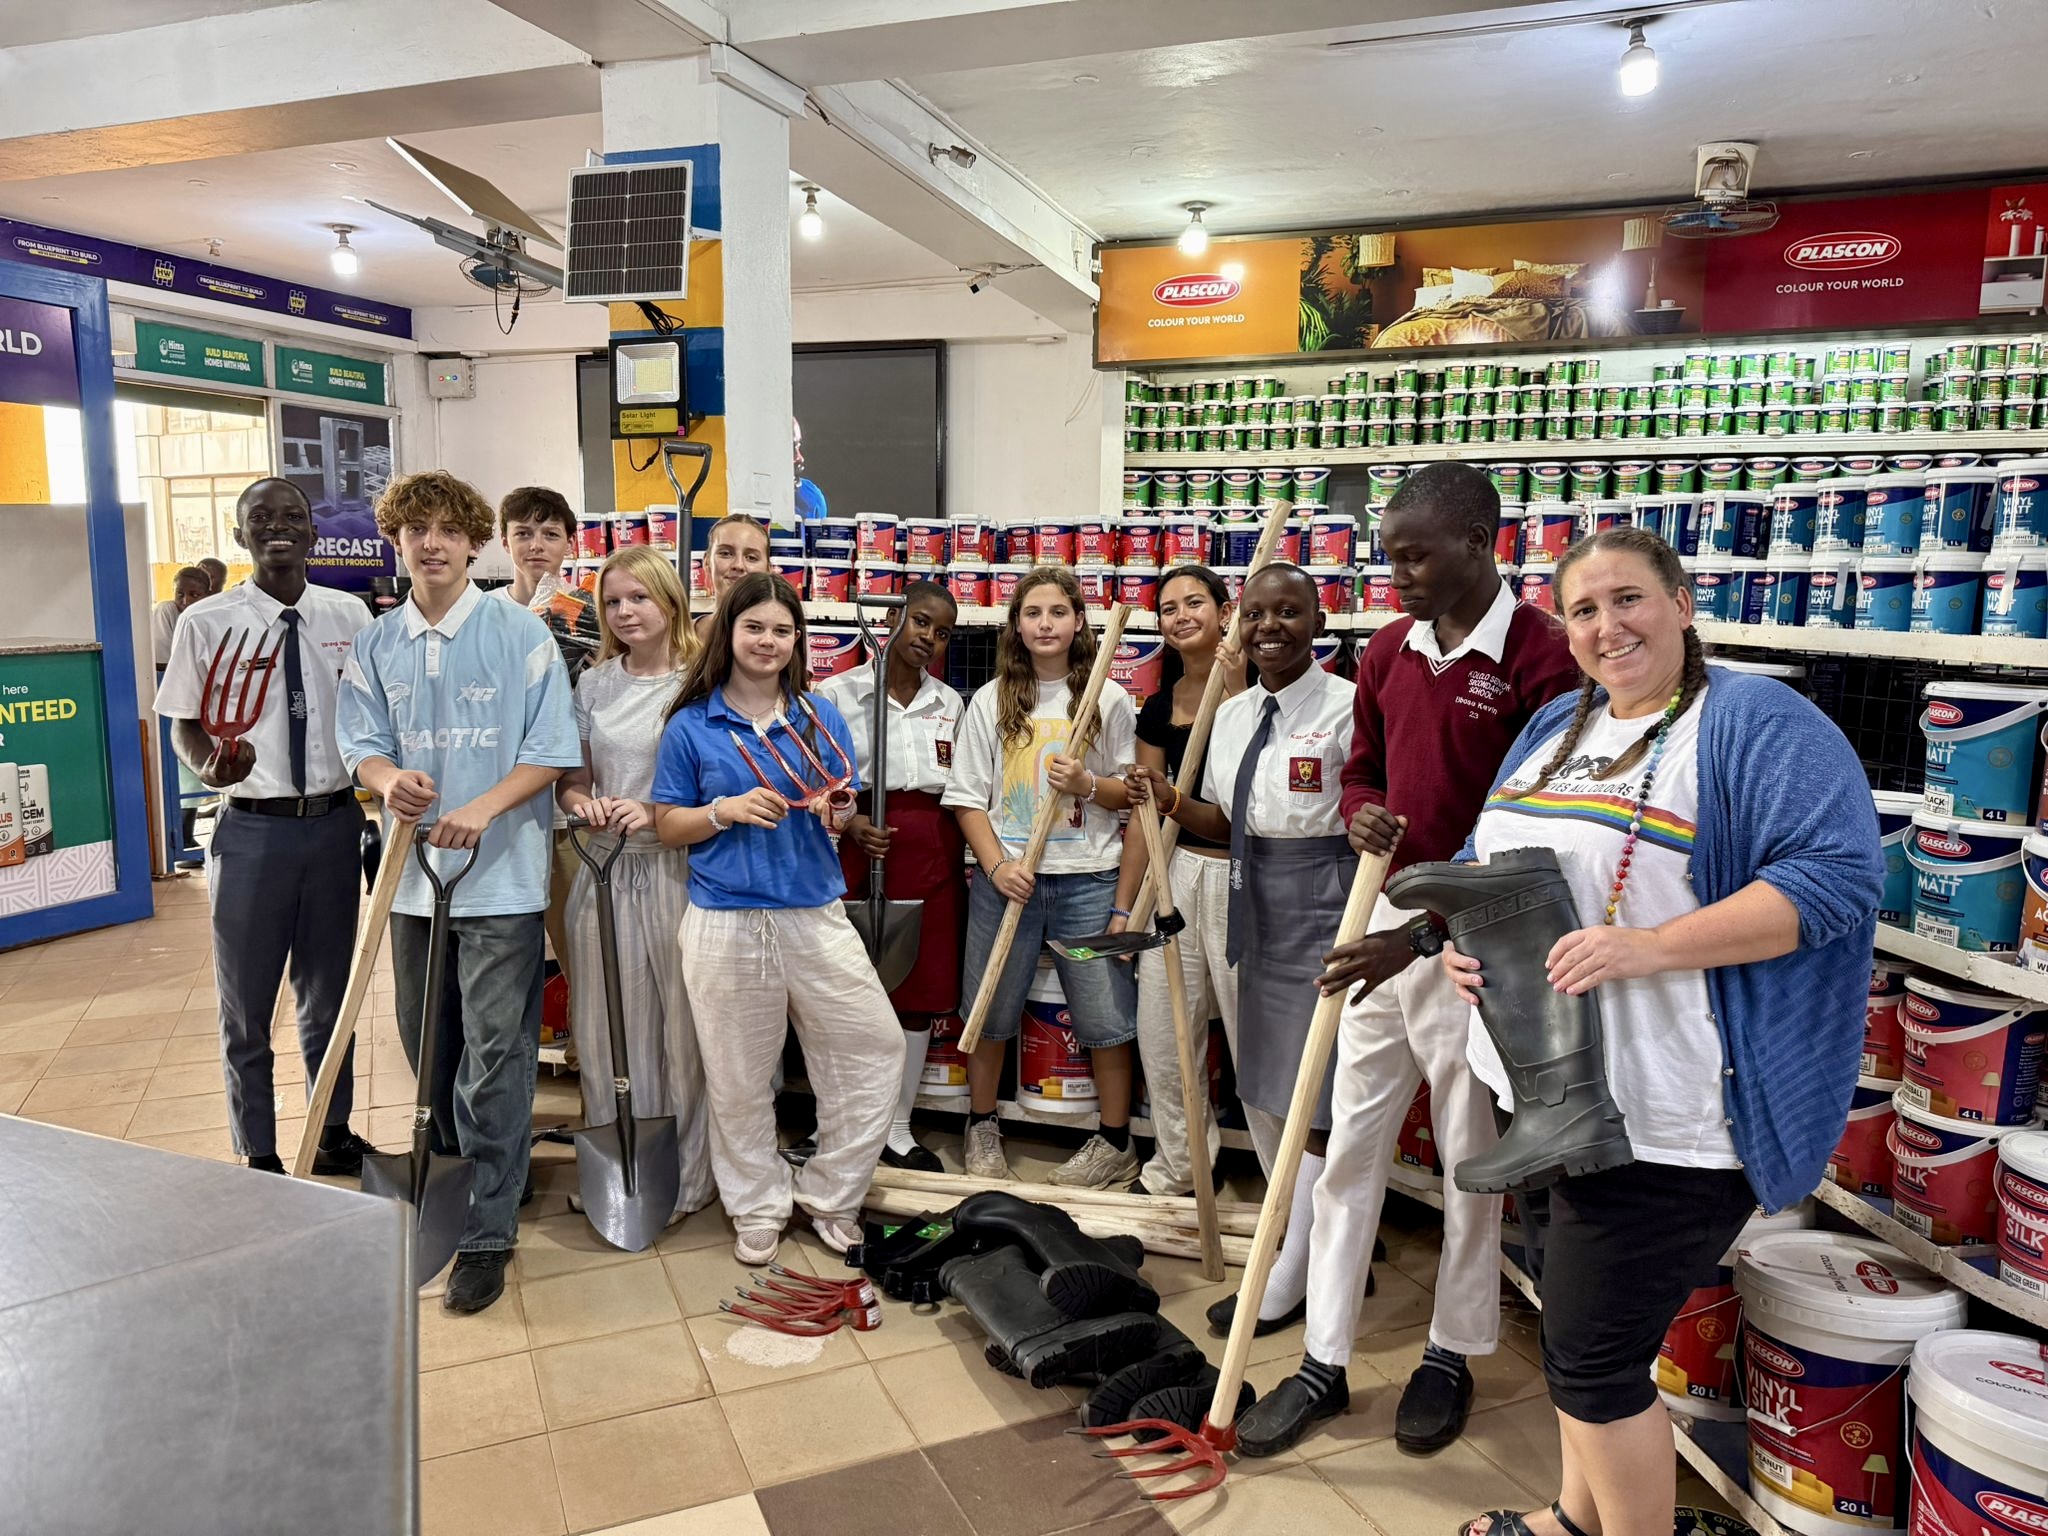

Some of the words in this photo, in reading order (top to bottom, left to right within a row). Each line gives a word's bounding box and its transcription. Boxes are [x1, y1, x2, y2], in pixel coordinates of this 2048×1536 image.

[17, 239, 36, 248] FROM
[36, 243, 70, 255] BLUEPRINT
[80, 251, 98, 260] BUILD
[1796, 242, 1889, 261] PLASCON
[1162, 282, 1231, 299] PLASCON
[1776, 282, 1824, 294] COLOUR
[1827, 280, 1858, 290] YOUR
[1861, 277, 1904, 289] WORLD
[1148, 316, 1185, 328] COLOUR
[1186, 315, 1211, 326] YOUR
[1212, 314, 1245, 325] WORLD
[168, 340, 185, 351] Hima
[205, 347, 221, 357] BUILD
[222, 349, 249, 361] BEAUTIFUL
[204, 357, 223, 368] HOMES
[223, 360, 236, 369] WITH
[236, 361, 251, 371] HIMA
[345, 558, 384, 567] PRODUCTS
[1523, 587, 1542, 595] VINYL
[1696, 588, 1716, 596] VINYL
[1811, 596, 1831, 605] MATT
[813, 658, 834, 668] SILK
[1111, 669, 1133, 679] SILK
[2, 685, 29, 695] here
[1468, 678, 1504, 696] SECONDARY
[1489, 675, 1512, 692] SENIOR
[1468, 686, 1494, 700] SCHOOL
[1468, 710, 1479, 719] 23
[1477, 701, 1498, 715] Kevin
[1570, 783, 1587, 793] ALL
[1589, 782, 1634, 797] COLOURS
[1986, 811, 1995, 819] 4
[1996, 812, 2004, 820] L
[1919, 836, 1964, 852] PLASCON
[1918, 873, 1960, 897] MATT
[1881, 911, 1889, 919] 4
[1891, 912, 1897, 920] L
[1936, 926, 1953, 938] WHITE
[1993, 943, 2001, 951] 4
[1904, 1034, 1928, 1059] SILK
[1961, 1109, 1970, 1117] 4
[1972, 1111, 1979, 1119] L
[1404, 1154, 1412, 1162] 20
[1897, 1163, 1928, 1188] SILK
[2006, 1219, 2048, 1251] SILK
[2004, 1268, 2022, 1286] GLACIER
[2022, 1276, 2041, 1292] GREEN
[1746, 1336, 1794, 1371] PLASCON
[1690, 1384, 1706, 1397] 20
[1709, 1389, 1716, 1398] L
[1750, 1366, 1803, 1412] VINYL
[1975, 1376, 2033, 1395] COLOUR
[1751, 1387, 1790, 1425] SILK
[1755, 1449, 1784, 1473] PEANUT
[1840, 1500, 1857, 1513] 20
[1861, 1504, 1869, 1515] L
